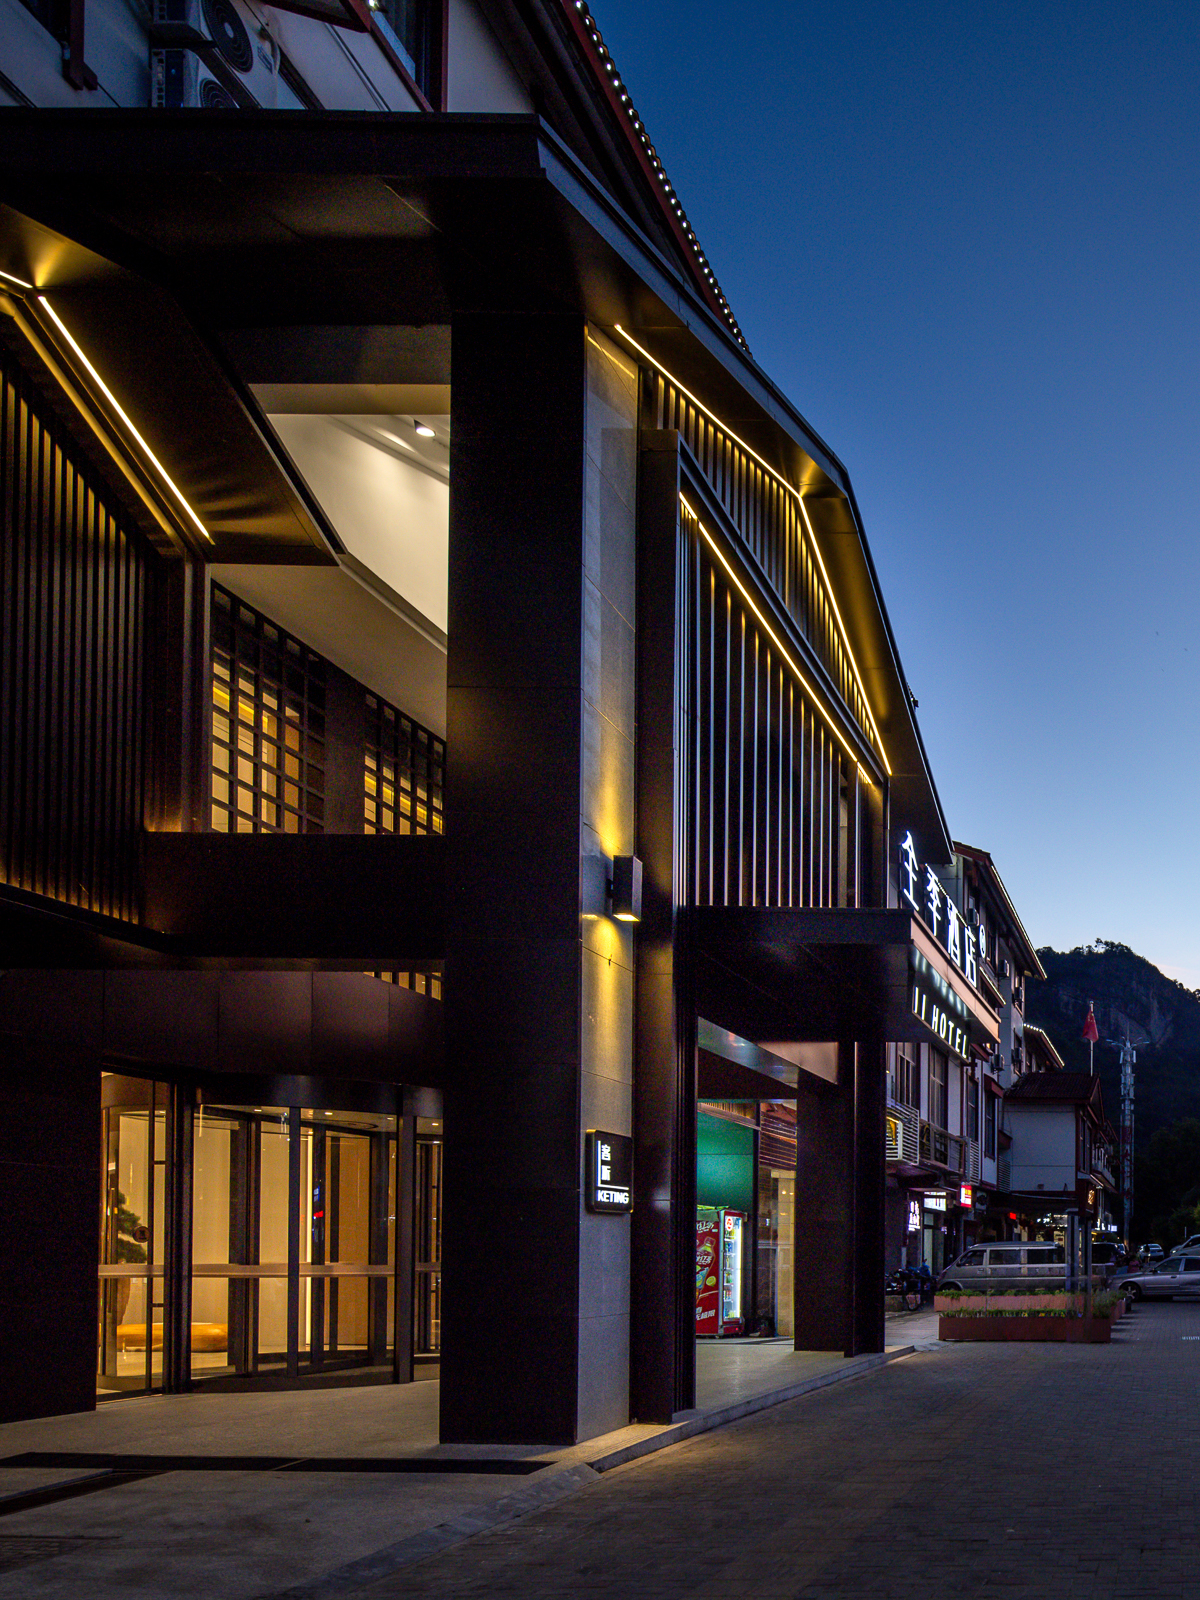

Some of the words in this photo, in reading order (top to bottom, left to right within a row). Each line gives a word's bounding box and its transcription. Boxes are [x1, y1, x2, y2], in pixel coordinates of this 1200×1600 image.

[901, 830, 977, 988] 全季酒店
[932, 1004, 967, 1059] HOTEL
[597, 1189, 630, 1205] KETING
